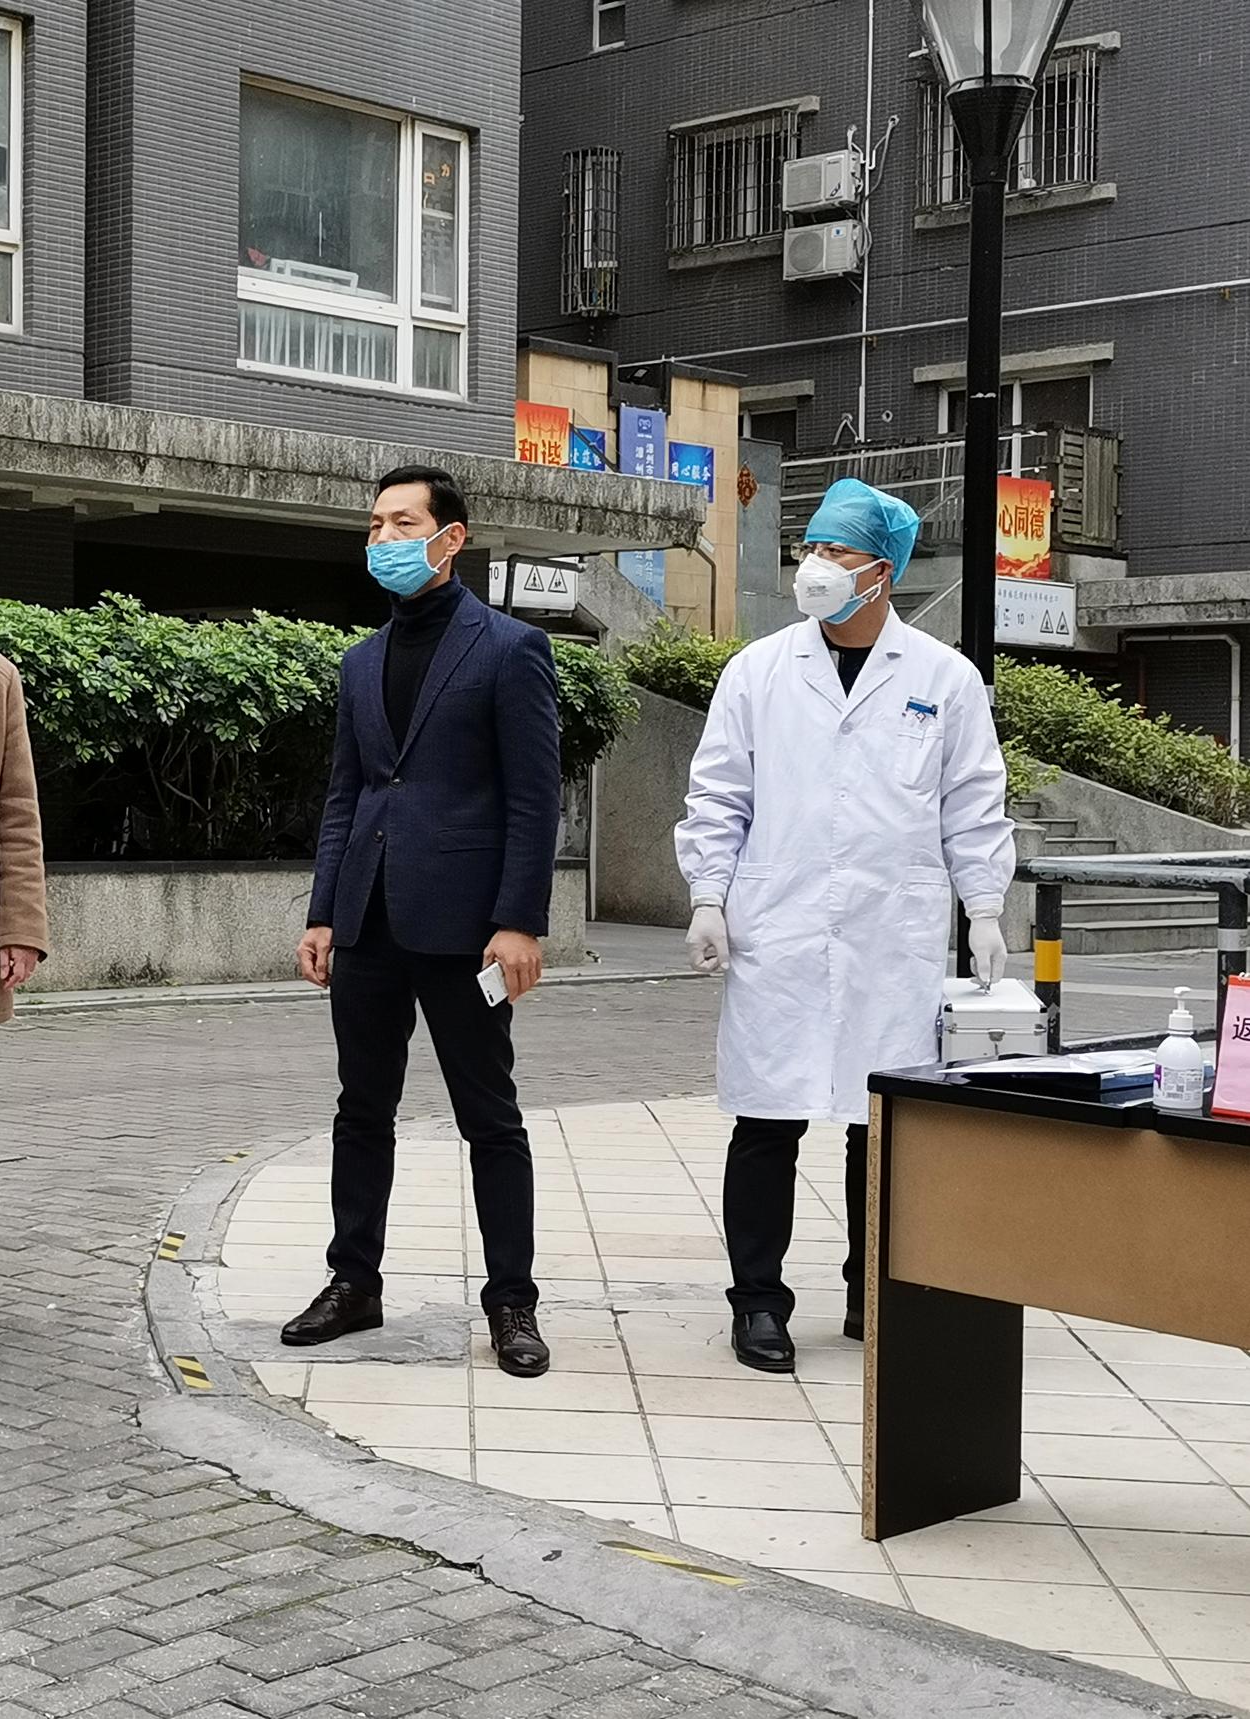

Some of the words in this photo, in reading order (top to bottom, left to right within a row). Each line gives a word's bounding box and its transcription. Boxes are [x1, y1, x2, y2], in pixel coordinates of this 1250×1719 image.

[518, 438, 562, 465] 和谐
[671, 461, 711, 481] 用心服务
[999, 504, 1044, 540] 心同德
